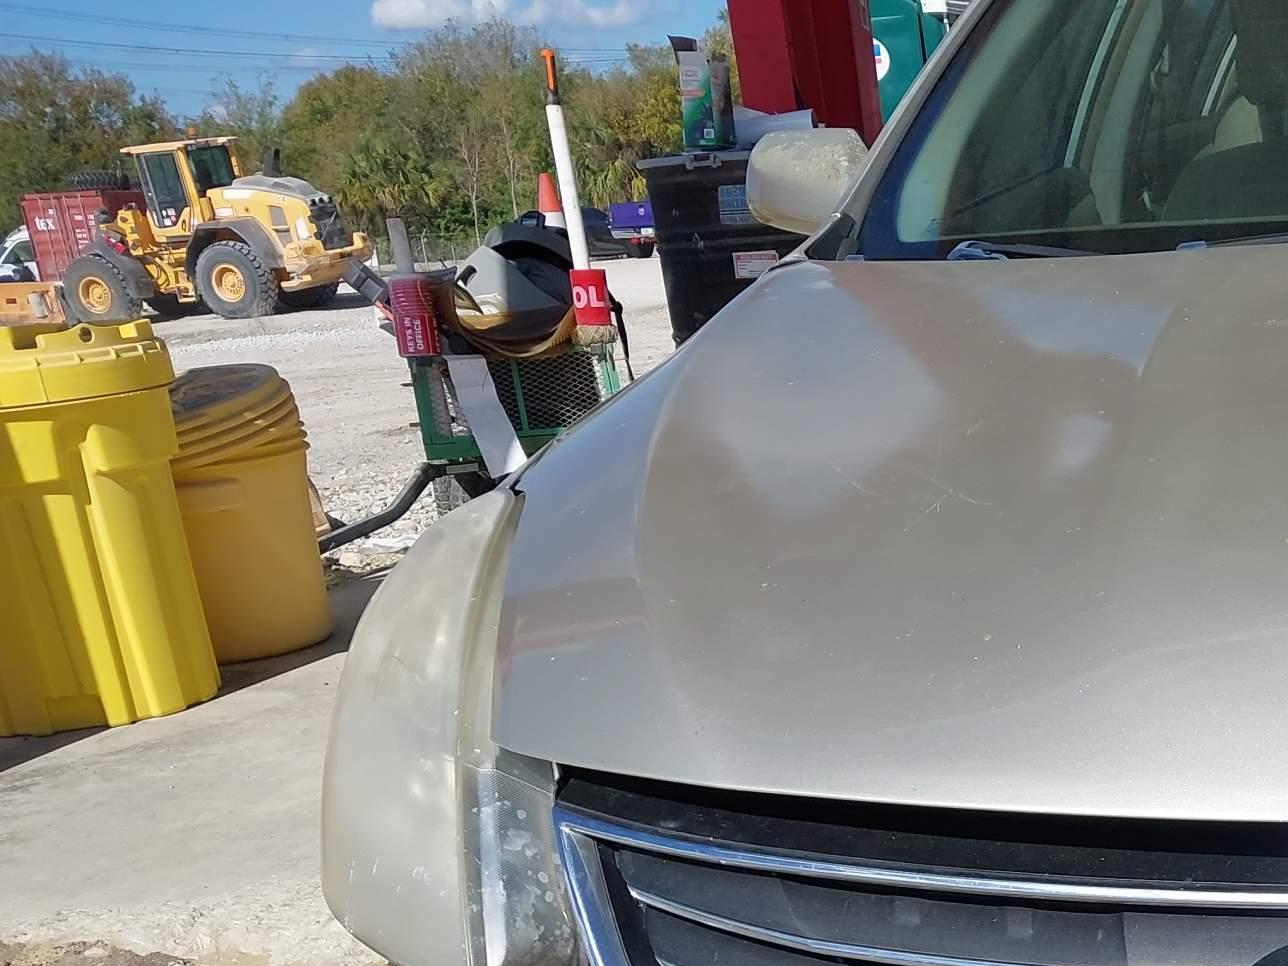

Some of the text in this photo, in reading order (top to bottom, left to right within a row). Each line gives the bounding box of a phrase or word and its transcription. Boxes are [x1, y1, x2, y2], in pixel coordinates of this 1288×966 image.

[34, 215, 56, 231] tex
[573, 285, 605, 308] OL
[404, 317, 415, 352] KEYS IN
[413, 319, 424, 350] OFFICE
